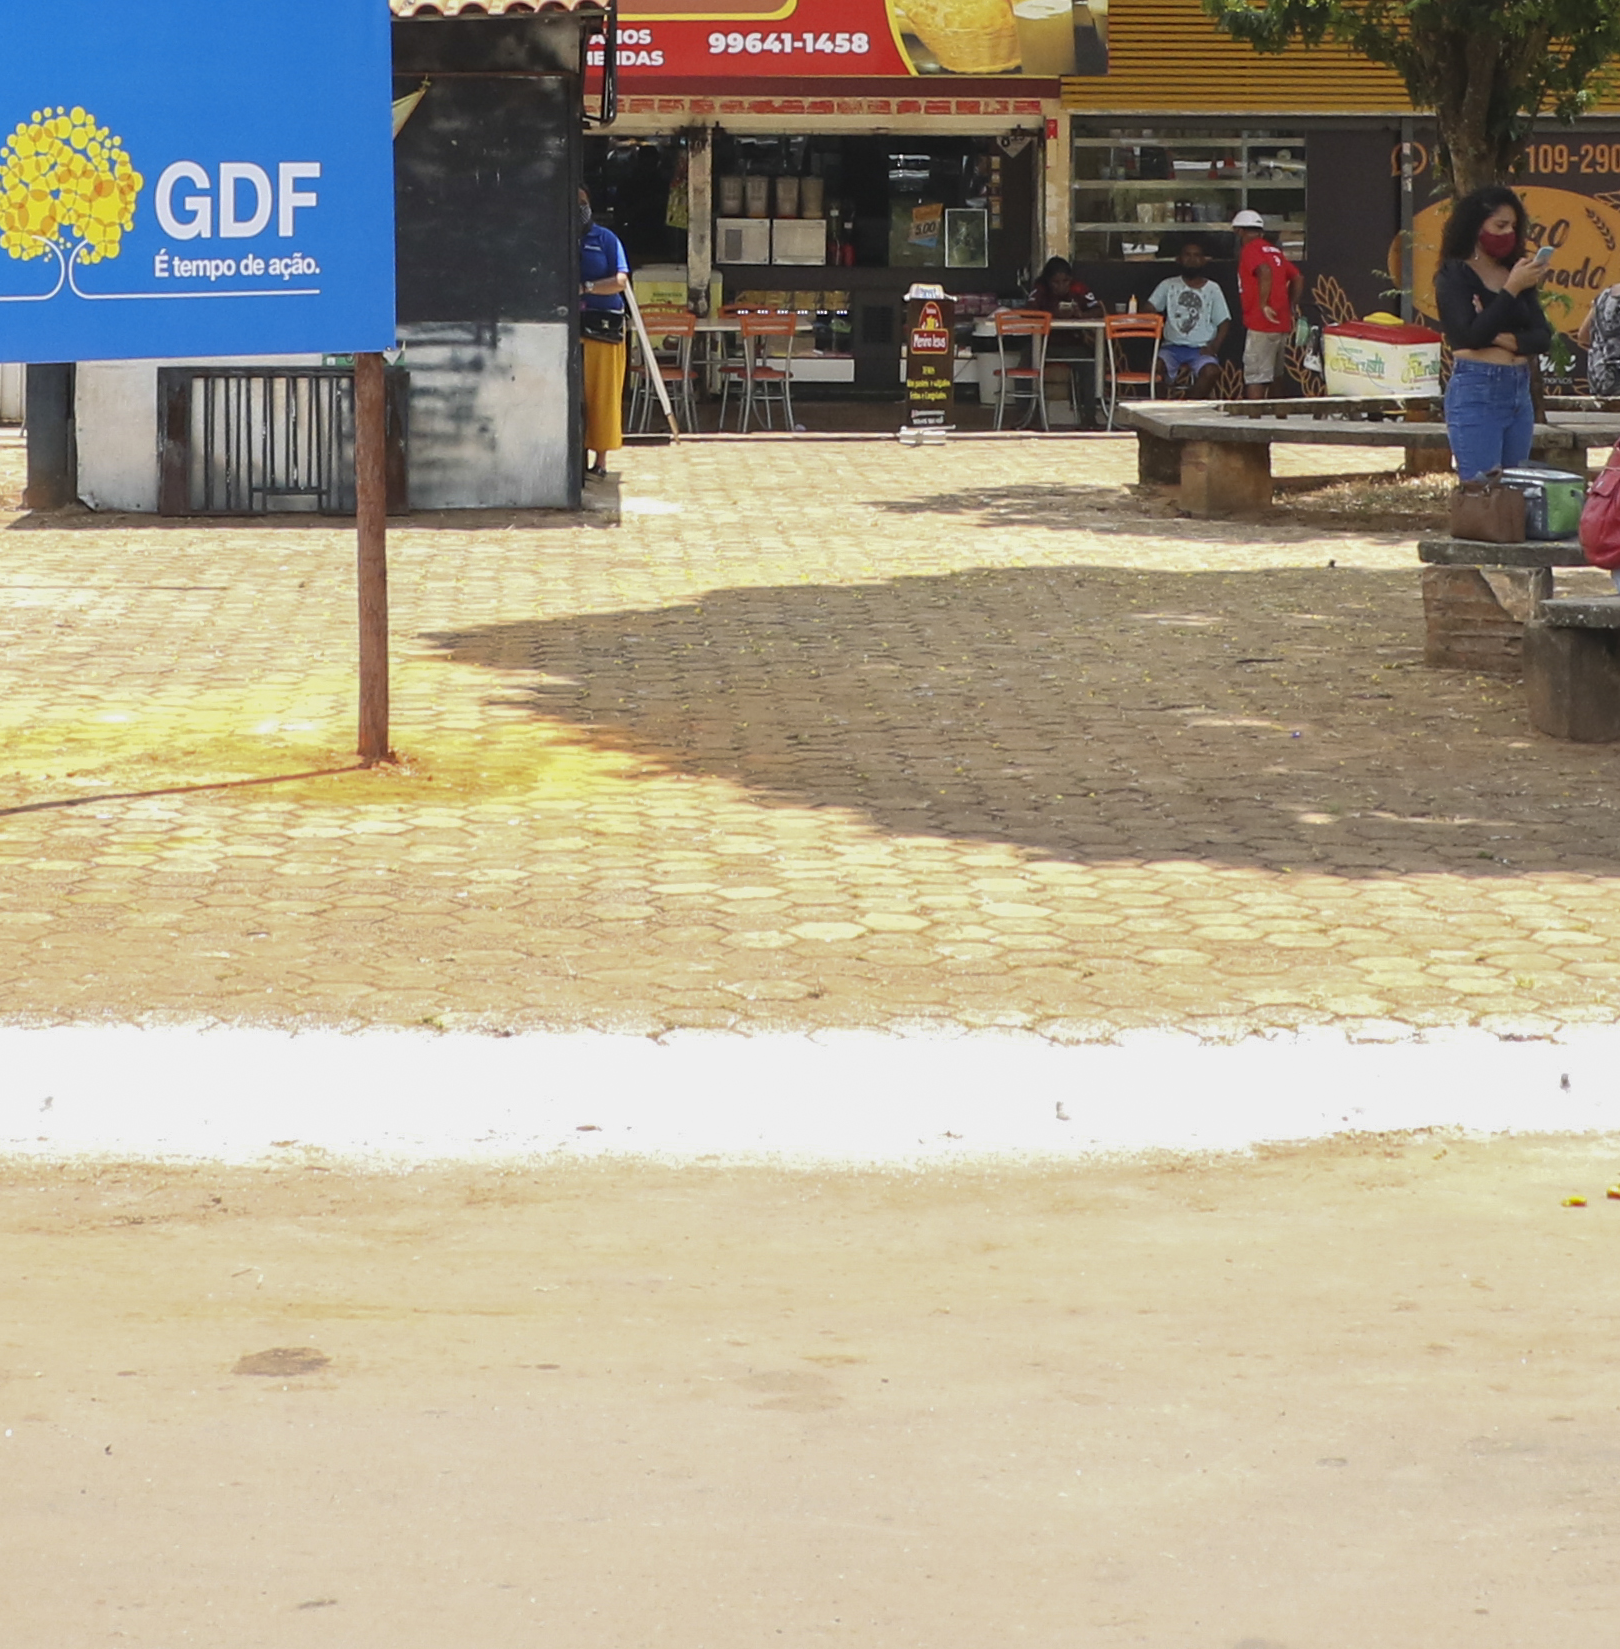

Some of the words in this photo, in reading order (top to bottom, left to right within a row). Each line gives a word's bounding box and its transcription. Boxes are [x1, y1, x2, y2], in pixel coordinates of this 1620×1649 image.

[707, 31, 871, 54] 99641-1458
[154, 160, 322, 241] GDF
[154, 248, 170, 278] É
[172, 255, 237, 282] tempo
[239, 253, 266, 277] de
[268, 252, 322, 282] ação.
